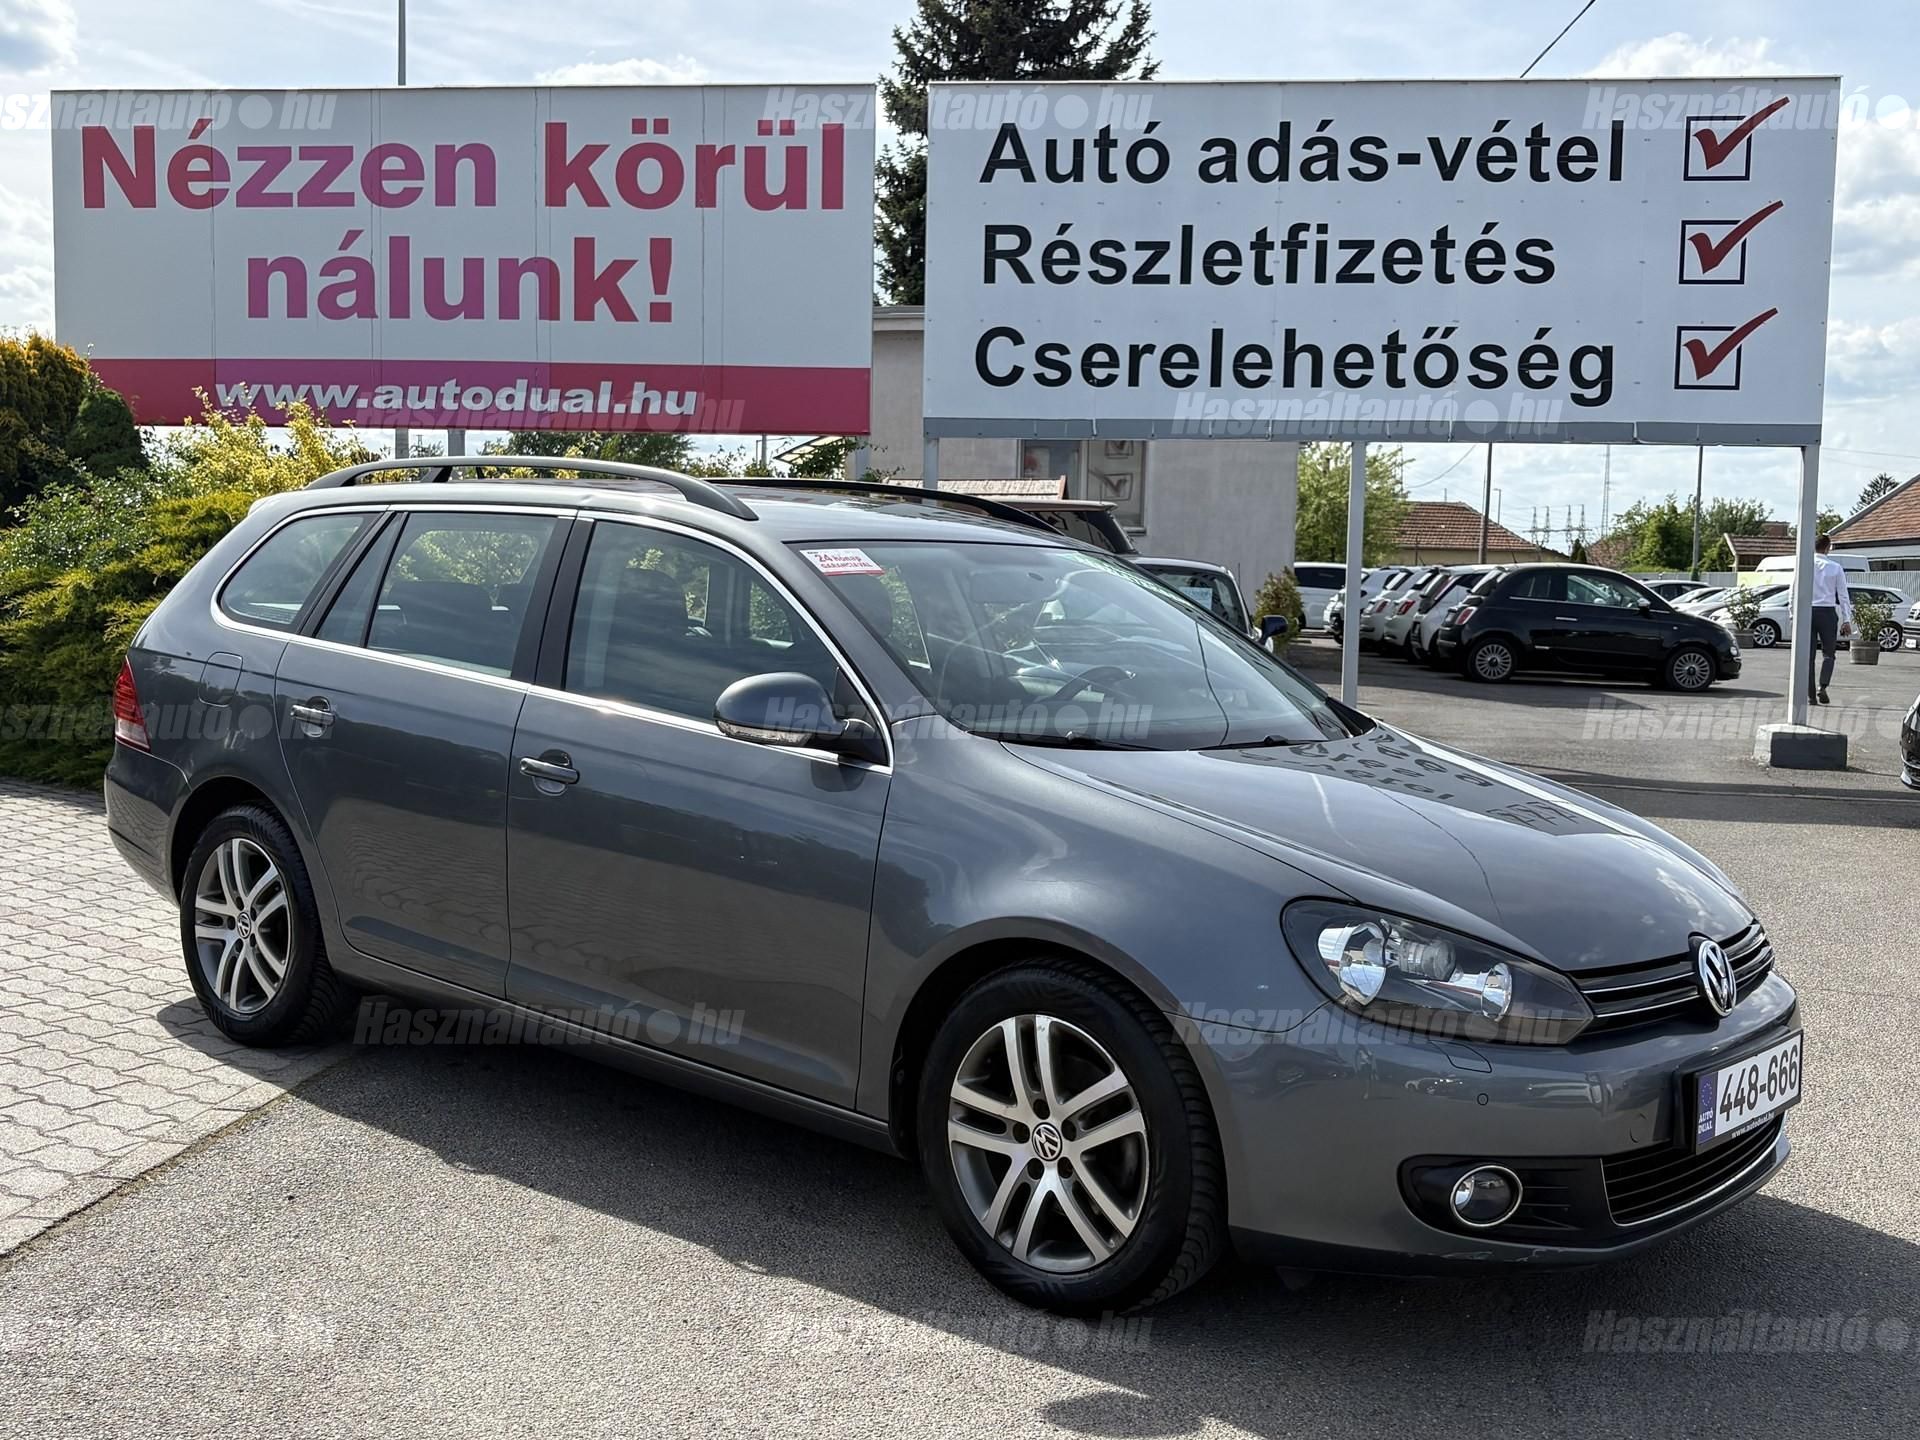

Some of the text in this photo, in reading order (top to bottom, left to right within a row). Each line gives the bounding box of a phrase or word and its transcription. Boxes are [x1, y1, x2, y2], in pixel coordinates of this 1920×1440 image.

[82, 118, 844, 211] Nézzen körül
[979, 119, 1624, 184] Autó adás-vétel
[247, 229, 673, 323] nálunk!
[983, 221, 1555, 286] Részletfizetés
[214, 377, 698, 416] www.autodual.hu
[975, 325, 1614, 408] Cserelehetőség
[1719, 1044, 1798, 1122] 448-666
[1697, 1120, 1713, 1135] DUAL
